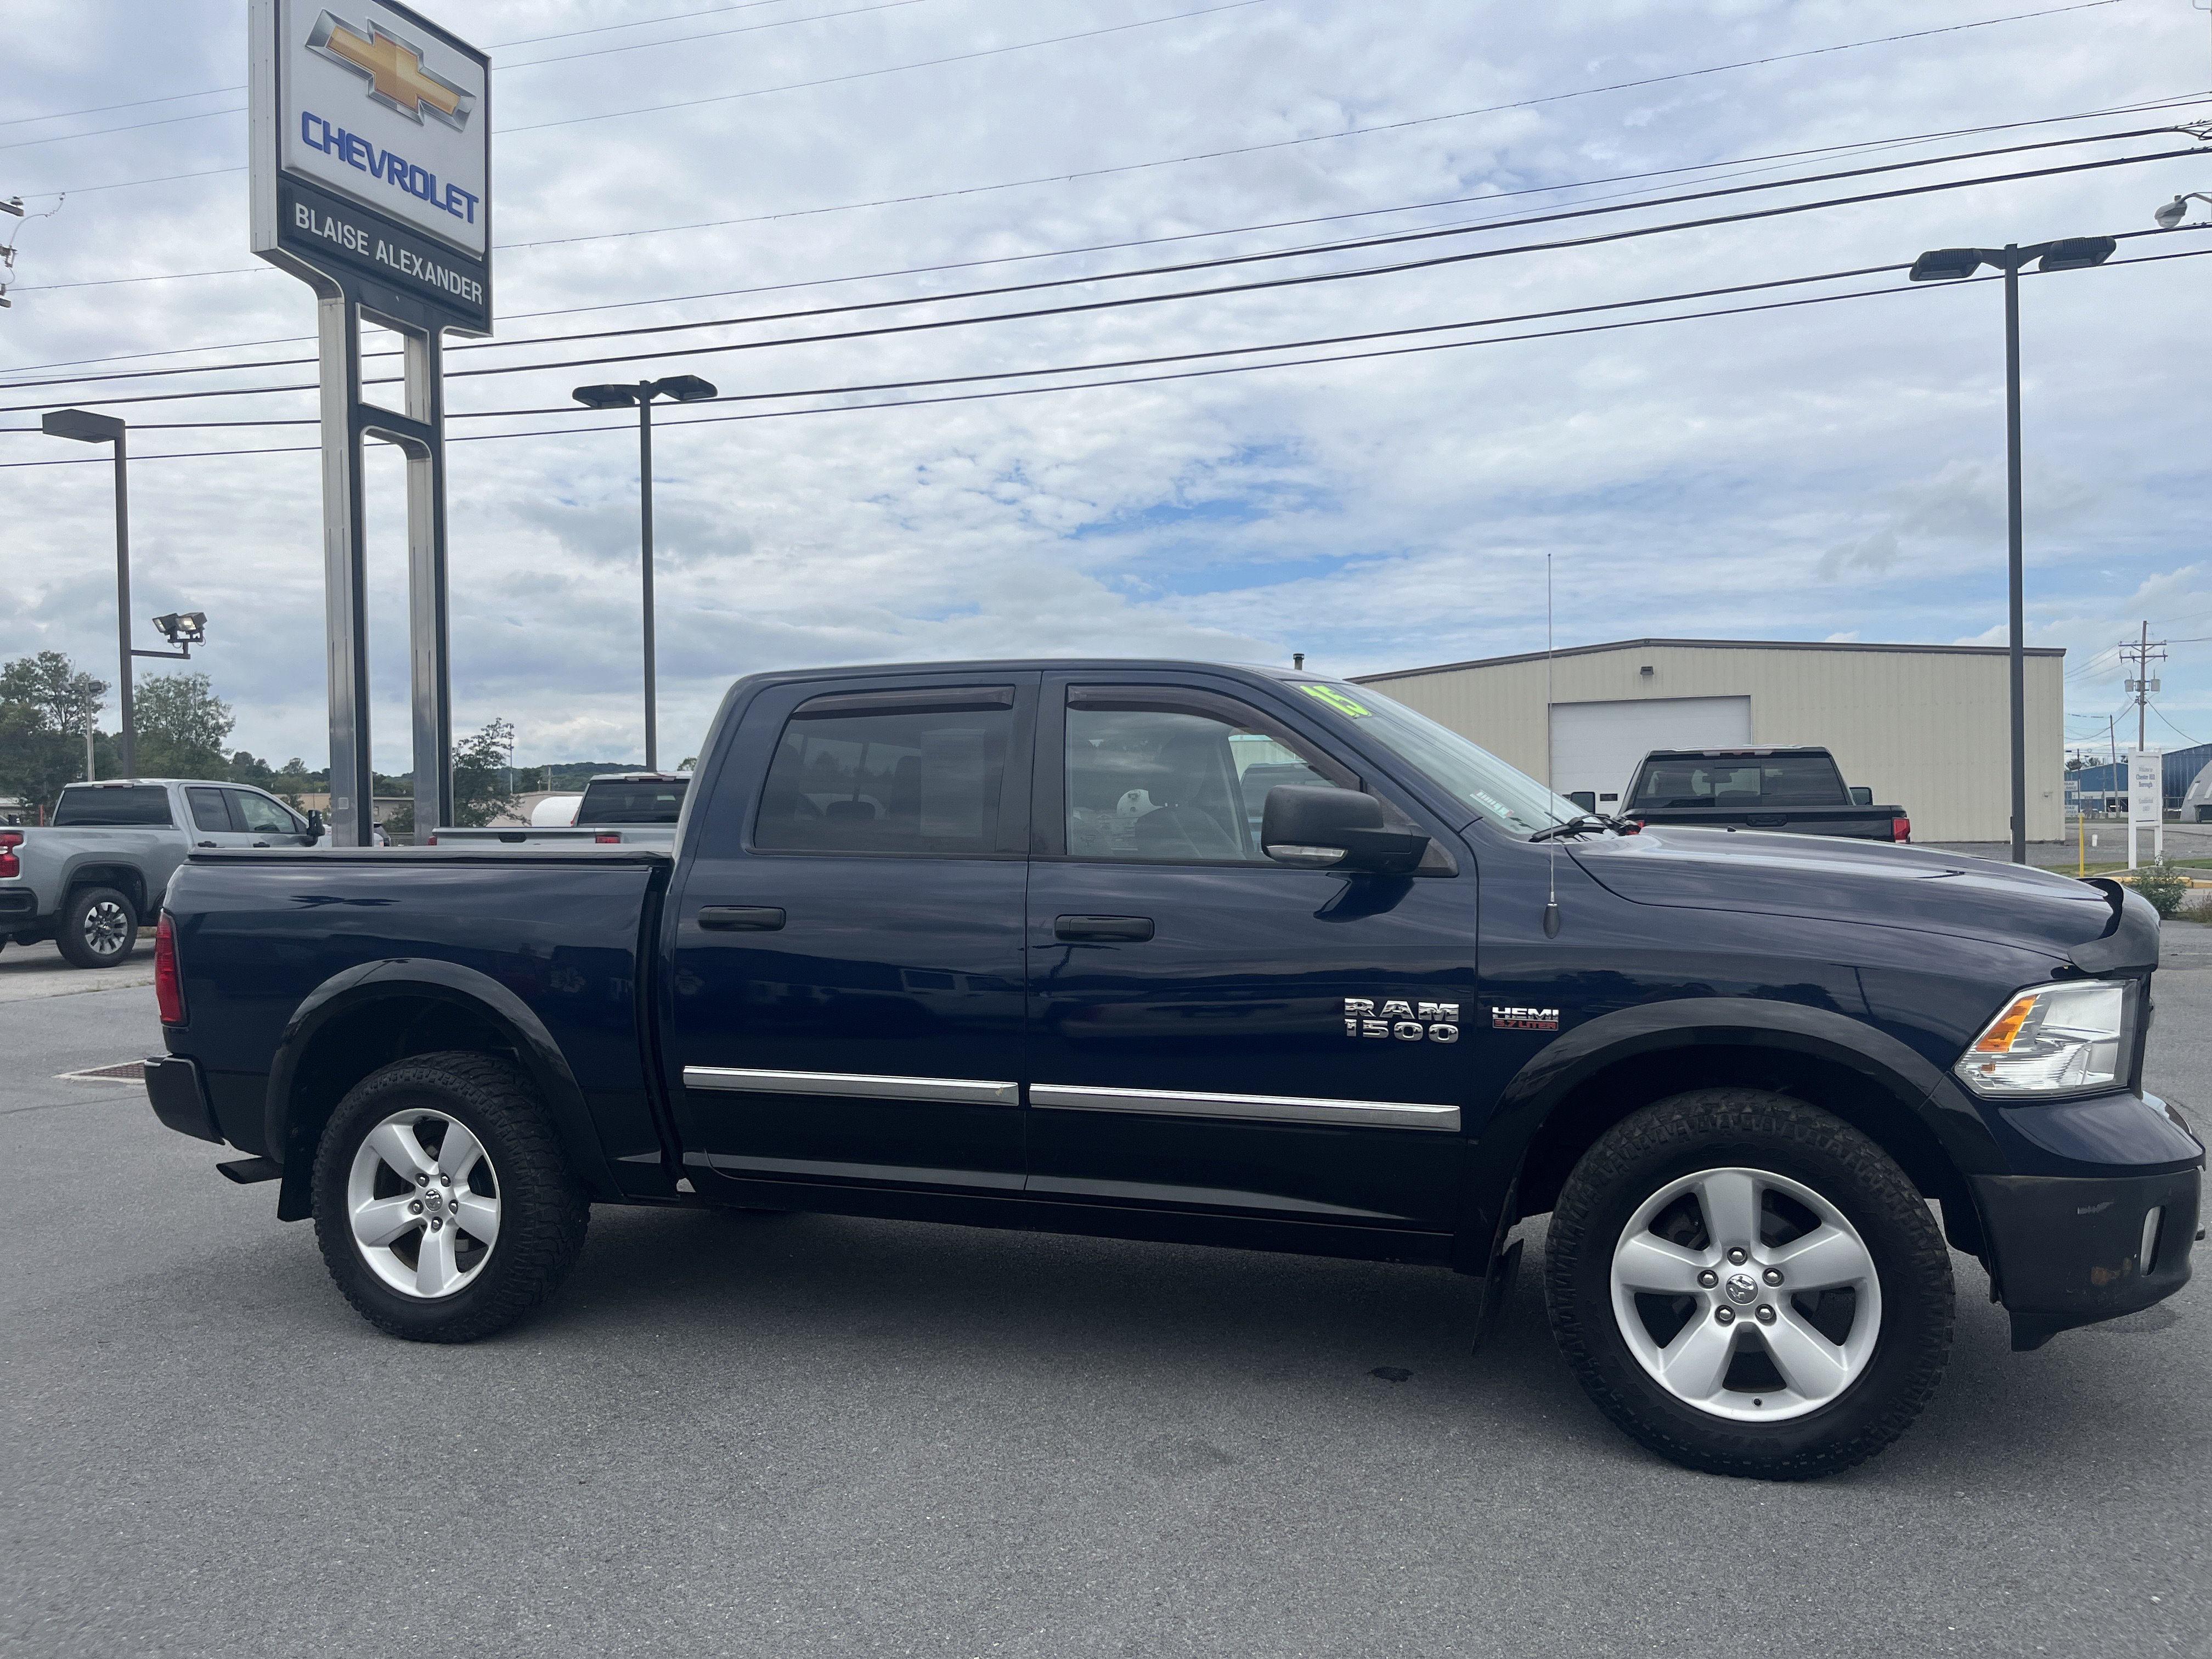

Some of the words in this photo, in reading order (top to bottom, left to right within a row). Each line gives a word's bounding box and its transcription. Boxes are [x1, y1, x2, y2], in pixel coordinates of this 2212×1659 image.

[302, 111, 479, 224] CHEVROLET
[295, 202, 369, 256] BLAISE
[375, 239, 483, 305] ALEXANDER
[1300, 685, 1372, 718] 15
[1344, 997, 1459, 1022] RAM
[1492, 1007, 1559, 1020] HEMI
[1344, 1019, 1459, 1043] 1500
[1494, 1019, 1516, 1028] 5.7
[1518, 1020, 1556, 1030] LITER
